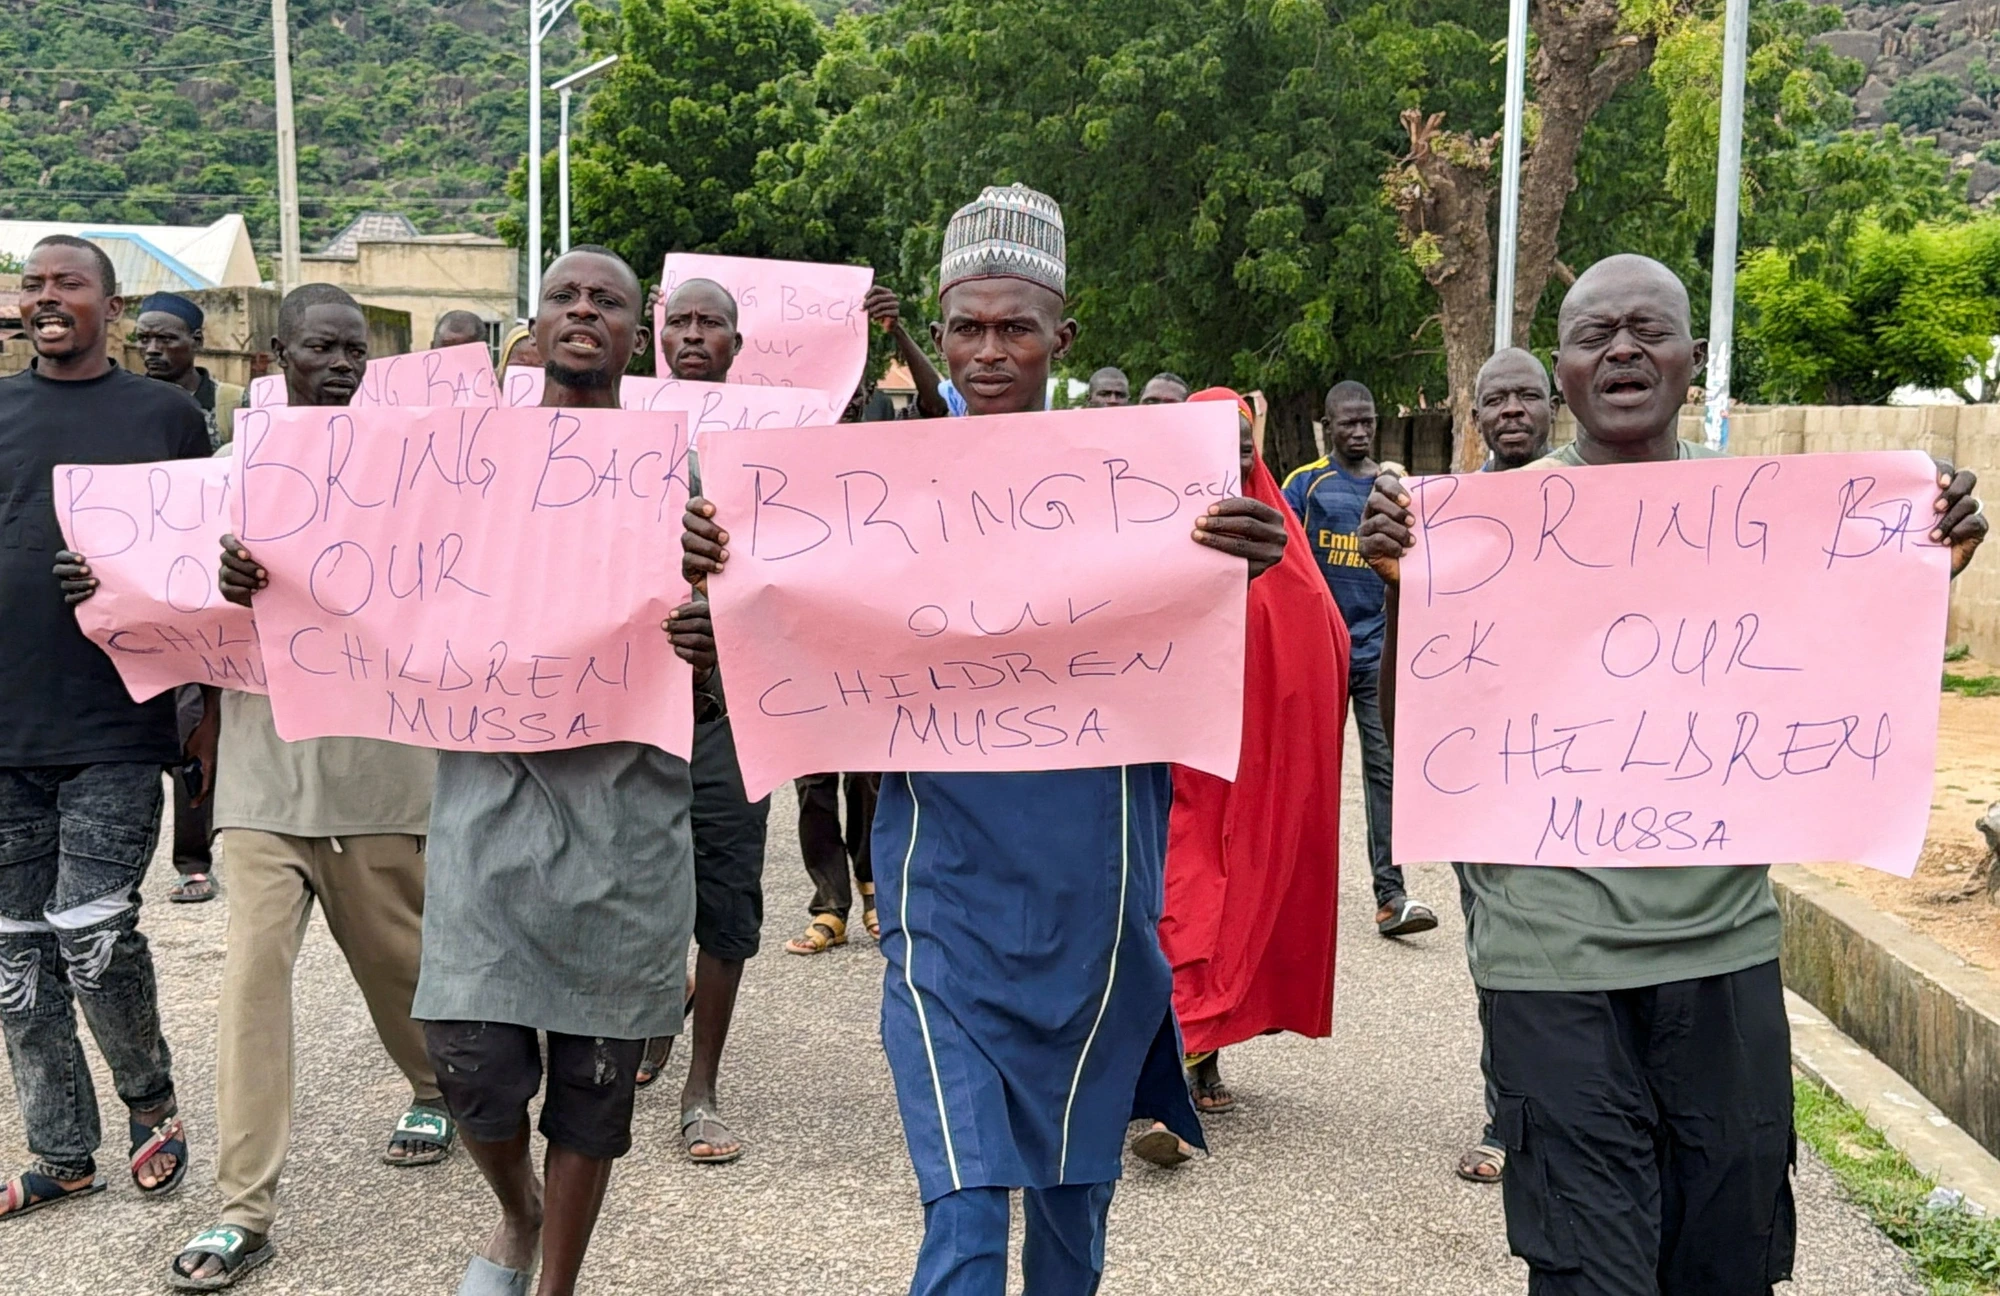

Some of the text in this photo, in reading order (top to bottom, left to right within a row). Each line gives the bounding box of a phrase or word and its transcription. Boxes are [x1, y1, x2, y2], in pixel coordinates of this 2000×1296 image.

[241, 409, 689, 541] BRING BACK
[1327, 550, 1345, 565] FLY
[1410, 461, 1780, 605] BRING
[310, 533, 490, 616] OUR
[289, 624, 630, 699] CHILDREN
[759, 642, 1173, 717] CHILDREN
[1600, 612, 1803, 686] OUR
[387, 690, 602, 746] MUSSA
[889, 704, 1110, 758] MUSSA
[1423, 710, 1892, 795] CHILDREN
